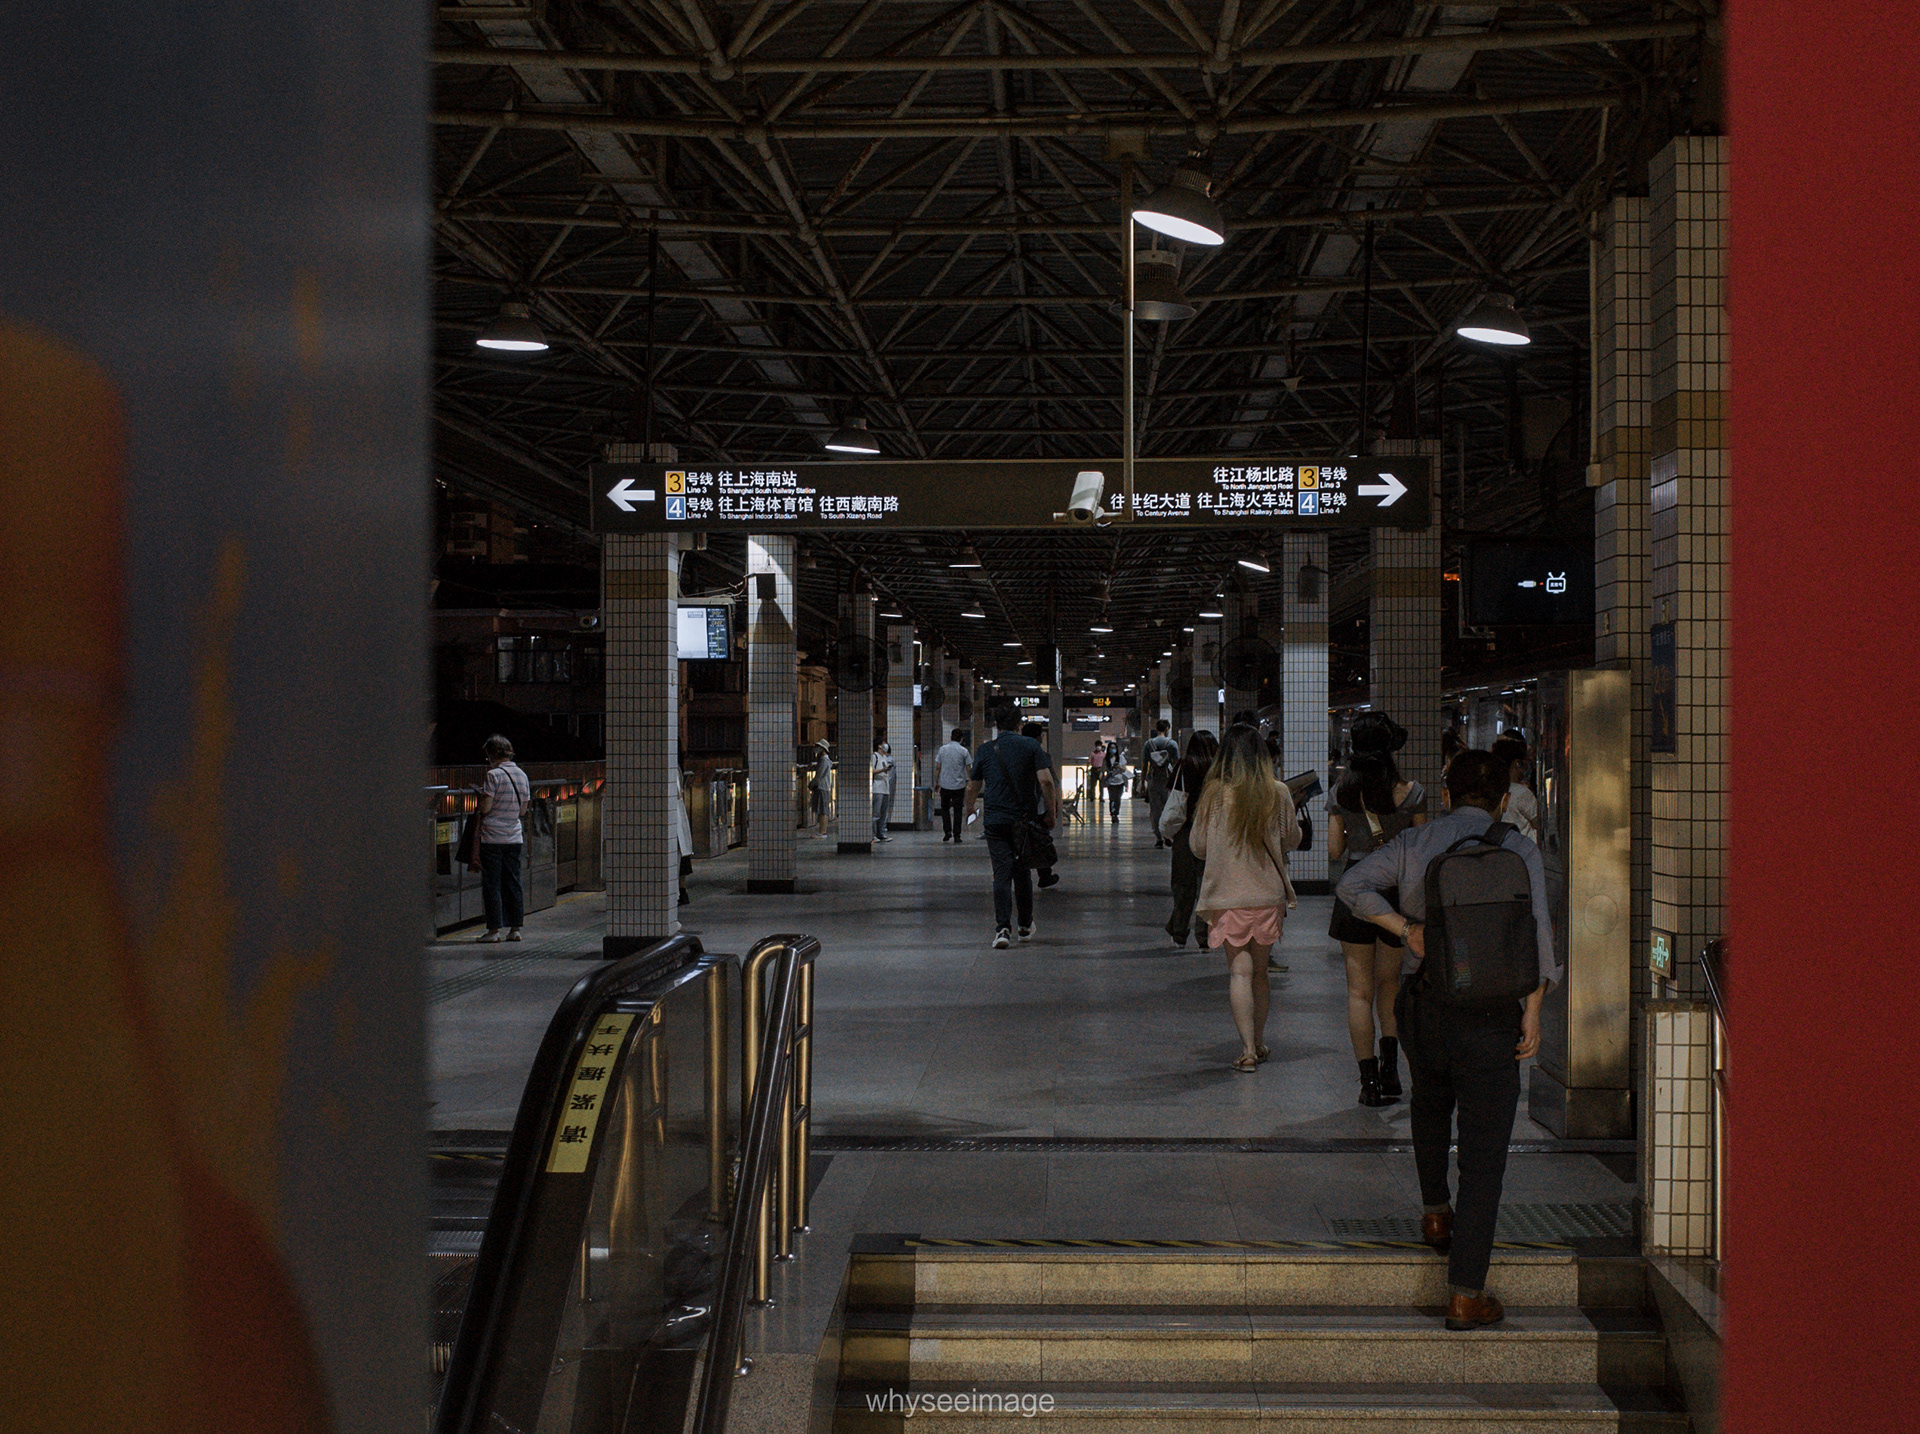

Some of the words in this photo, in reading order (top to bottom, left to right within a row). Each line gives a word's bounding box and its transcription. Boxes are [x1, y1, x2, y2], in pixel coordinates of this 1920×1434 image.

[669, 473, 681, 492] 3
[686, 472, 714, 486] 号线
[718, 471, 797, 487] 往上海南站
[1213, 466, 1295, 483] 往江杨北路
[1303, 468, 1315, 487] 3
[1319, 466, 1348, 481] 号线
[687, 486, 701, 494] Line
[727, 487, 754, 495] Shanghai
[773, 487, 795, 495] Railway
[1247, 483, 1276, 491] Jiangyang
[669, 498, 682, 517] 4
[687, 497, 714, 511] 号线
[718, 496, 813, 512] 往上海体育馆
[819, 495, 899, 512] 往西藏南路
[1110, 492, 1191, 509] 往世纪大道
[1197, 492, 1294, 509] 往上海火车站
[1301, 494, 1315, 513] 4
[1319, 492, 1348, 507] 号线
[727, 513, 754, 521] Shanghai
[559, 1025, 622, 1144] 请紧握扶手
